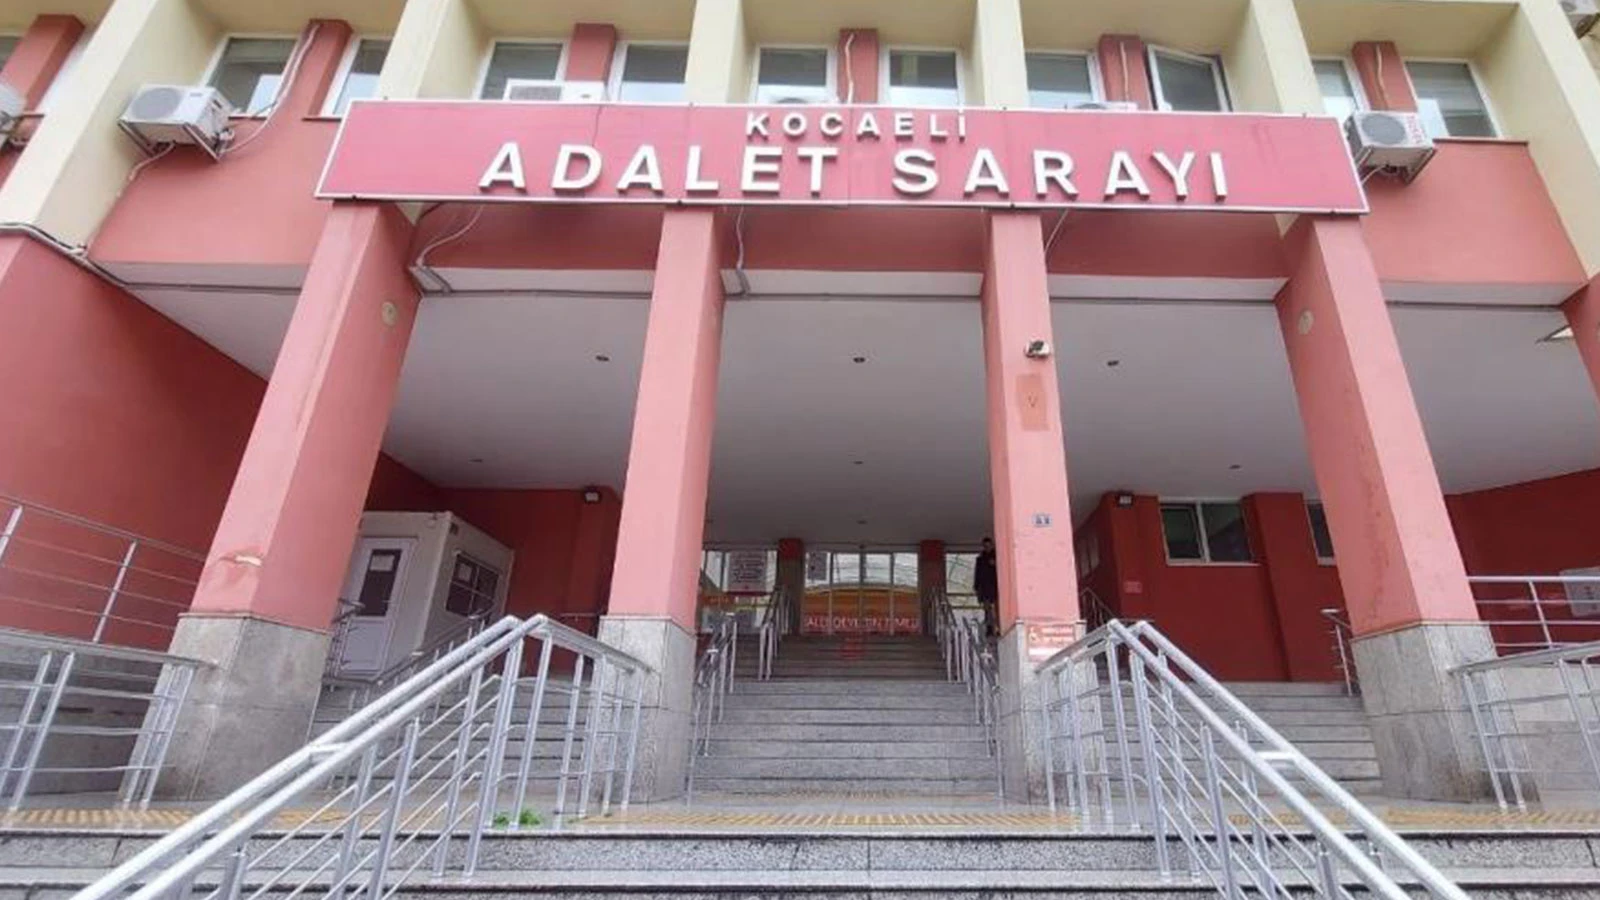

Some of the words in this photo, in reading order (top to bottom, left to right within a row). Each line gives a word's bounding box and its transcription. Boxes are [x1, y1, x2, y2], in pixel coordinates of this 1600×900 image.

[745, 108, 967, 140] KOCAELİ
[478, 142, 839, 197] ADALET
[892, 148, 1228, 201] SARAYI
